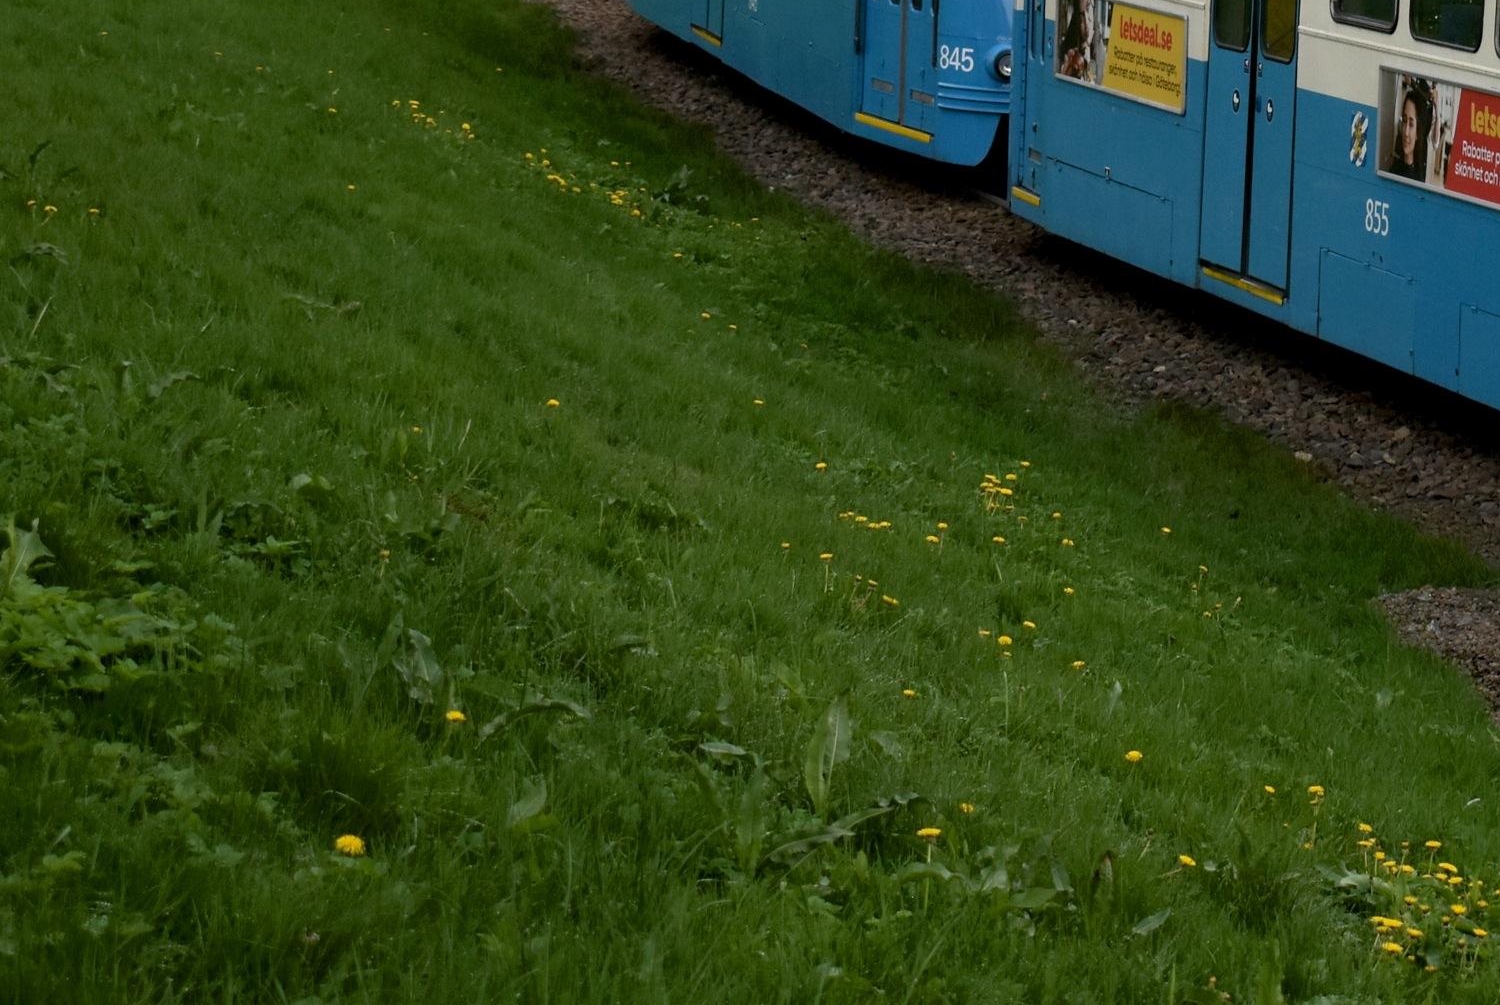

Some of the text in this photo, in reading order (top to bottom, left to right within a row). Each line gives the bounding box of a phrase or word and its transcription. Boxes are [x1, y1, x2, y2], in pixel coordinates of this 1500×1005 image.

[1120, 15, 1172, 51] letsdeal.se
[940, 44, 974, 72] 845
[1462, 140, 1494, 160] Rabatter
[1455, 160, 1483, 181] skönhet
[1484, 169, 1498, 185] och
[1365, 198, 1390, 236] 855
